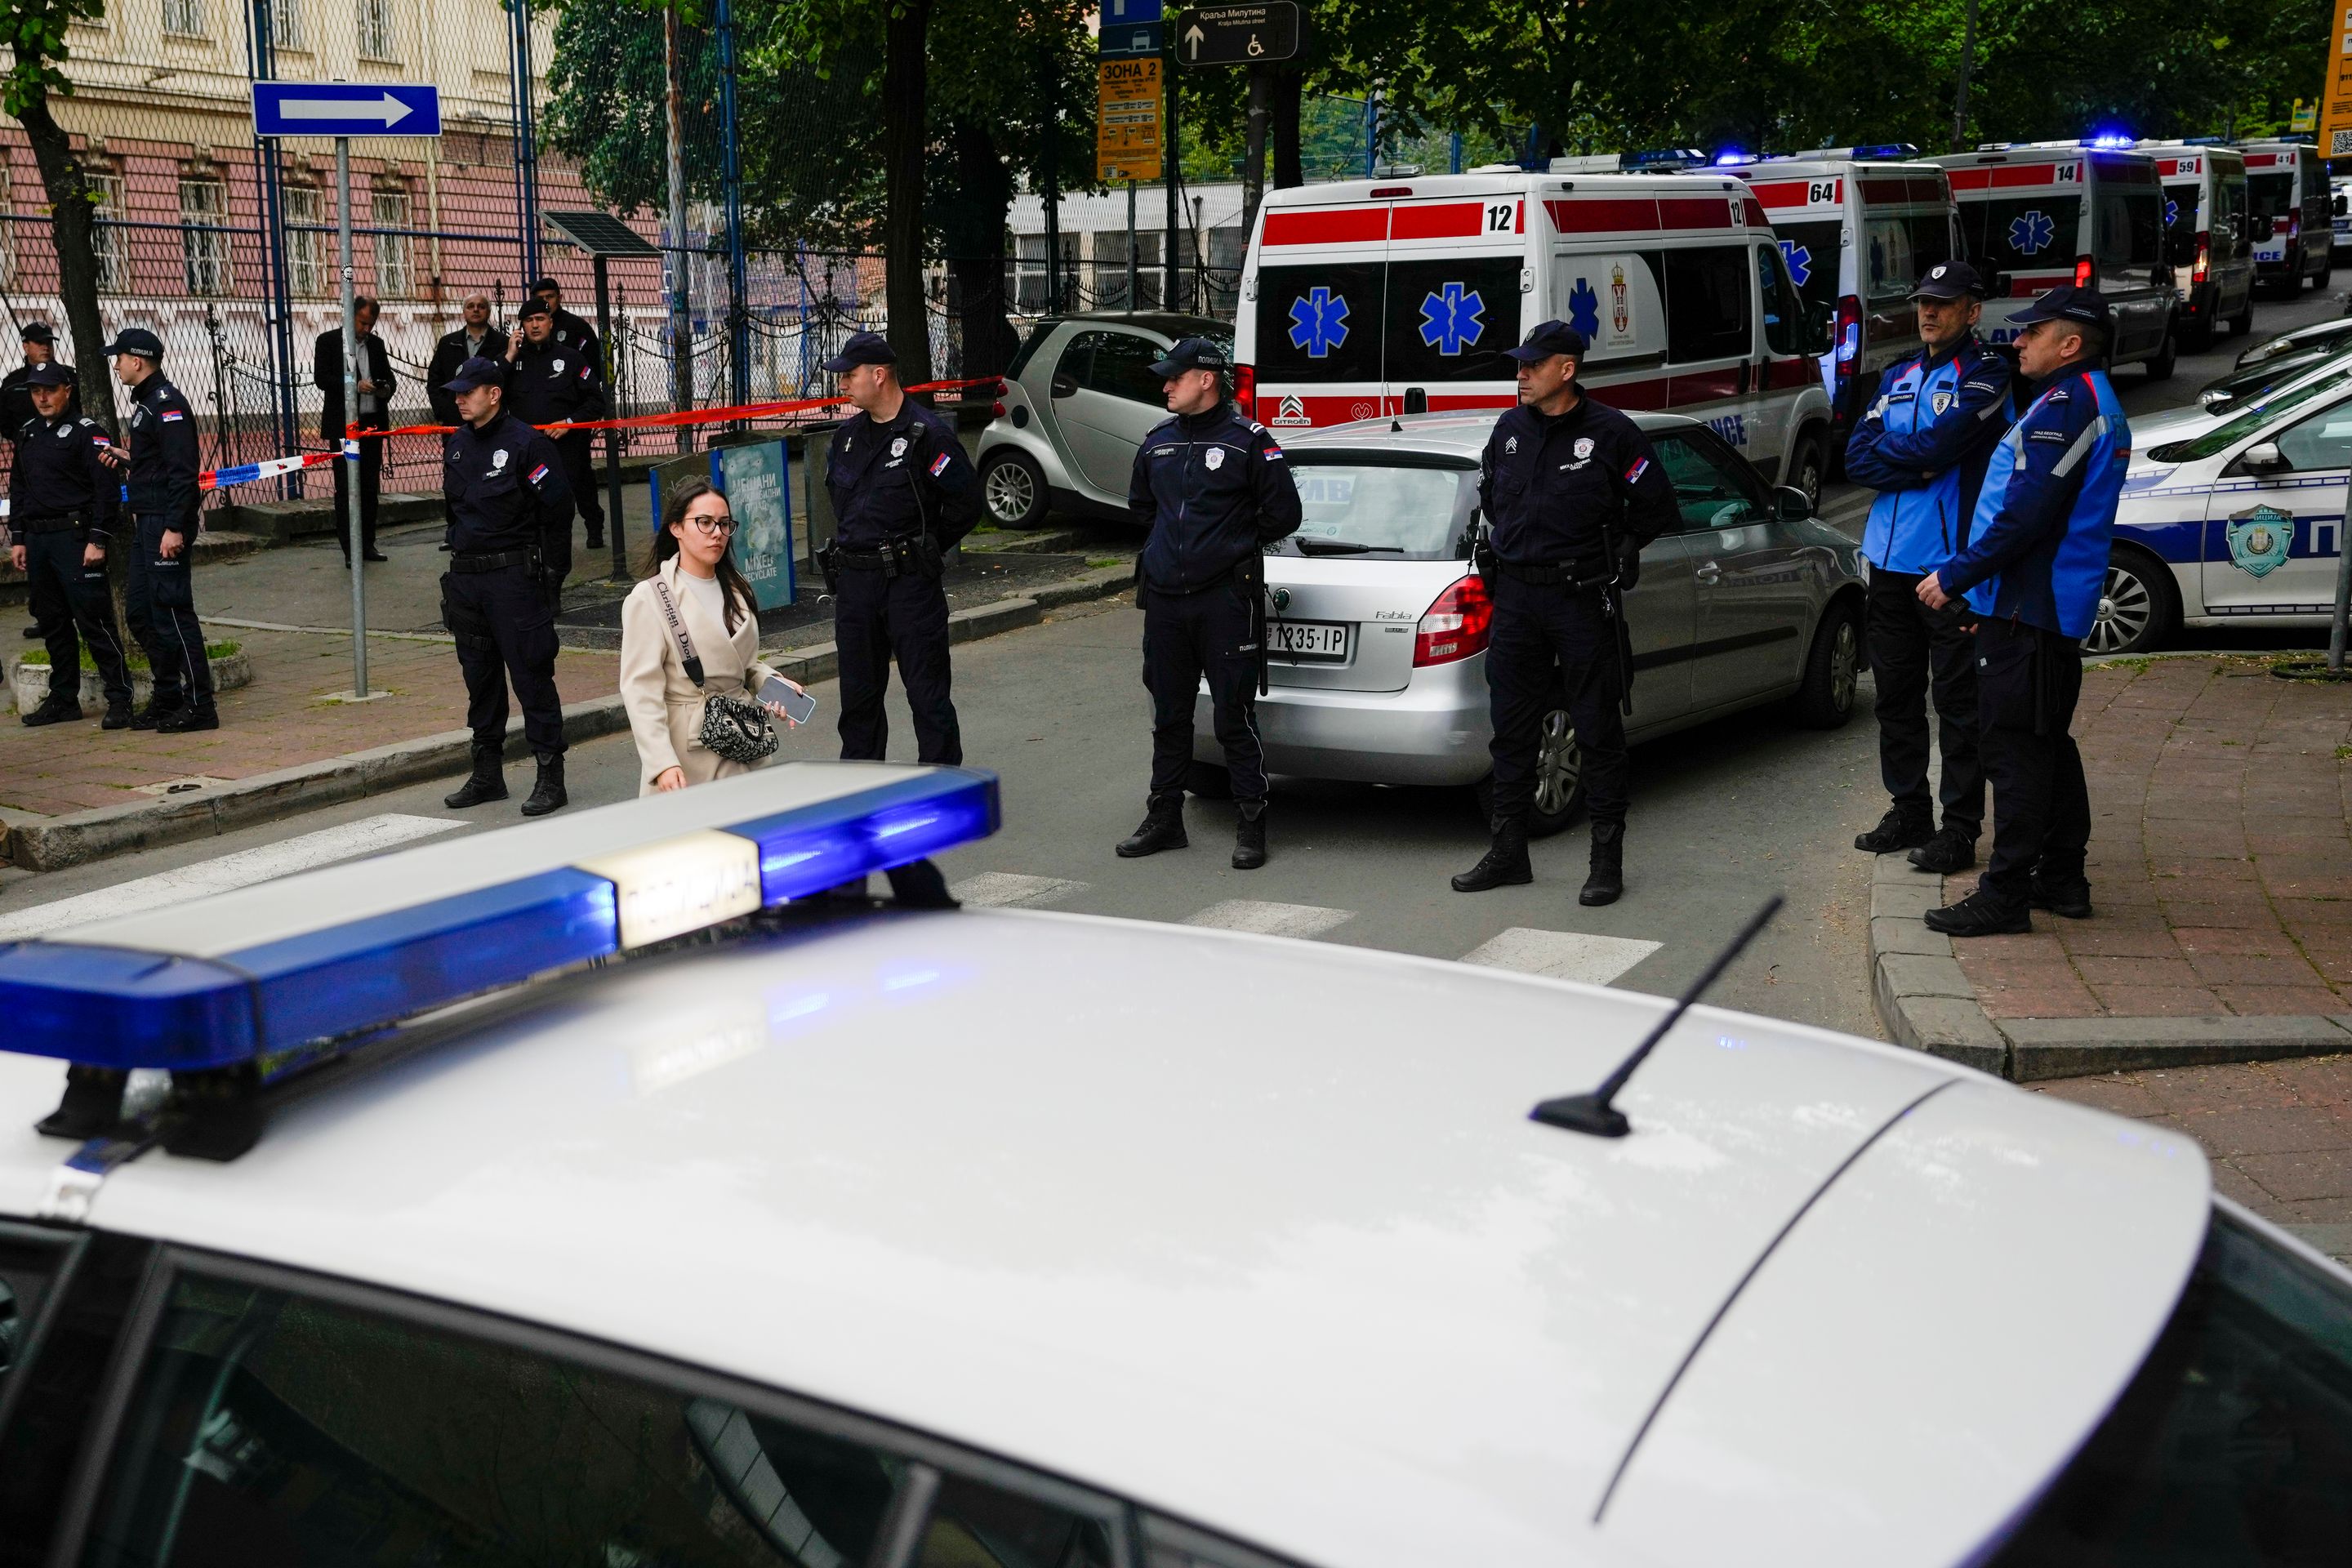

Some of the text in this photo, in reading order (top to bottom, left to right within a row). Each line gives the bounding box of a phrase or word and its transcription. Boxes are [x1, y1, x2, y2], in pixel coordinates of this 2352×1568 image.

[1200, 8, 1266, 20] Краља Милутина
[1104, 62, 1156, 79] ЗОНА 2
[2179, 161, 2194, 172] 59
[2277, 155, 2290, 163] 41
[2057, 165, 2074, 181] 14
[1810, 183, 1833, 203] 64
[1487, 205, 1512, 231] 12
[1731, 202, 1742, 224] 12
[657, 581, 692, 660] Christian Dior
[1376, 611, 1412, 619] Fabia
